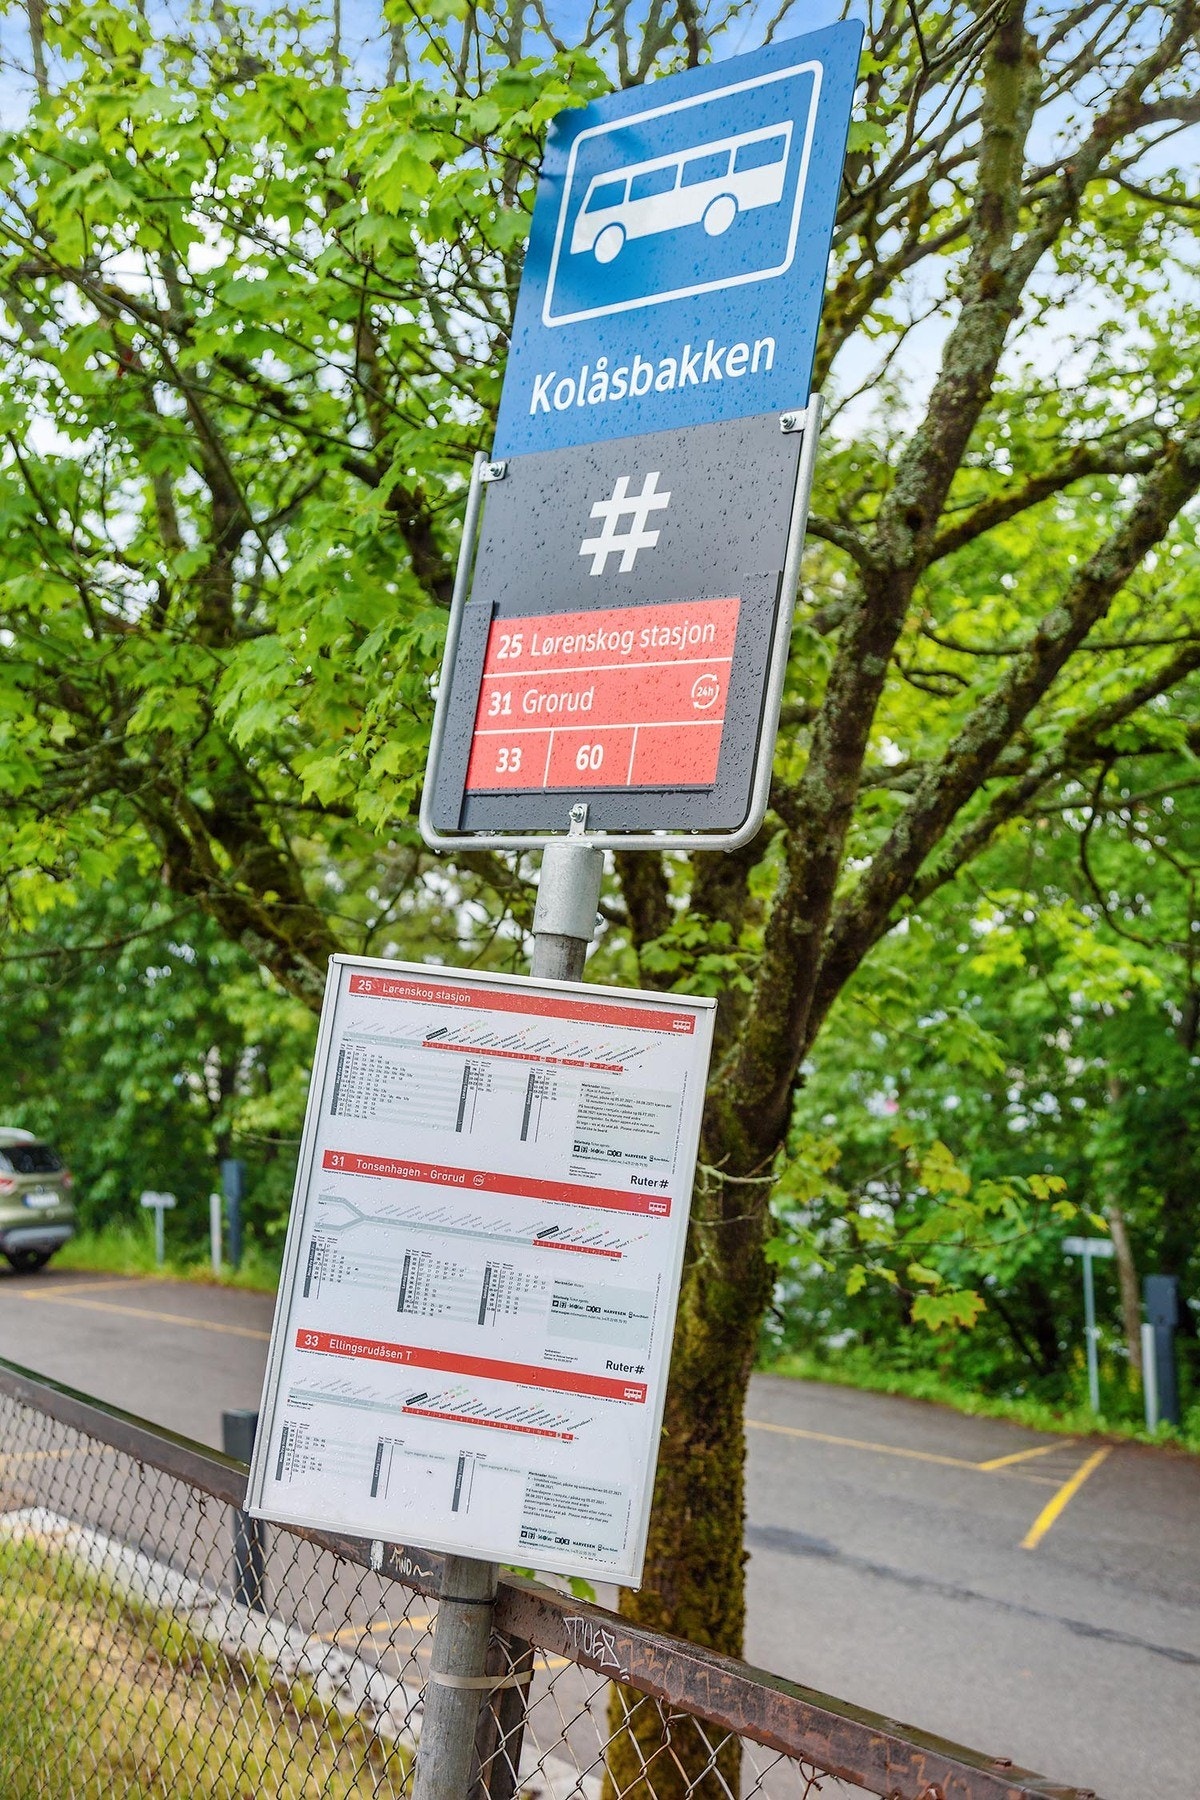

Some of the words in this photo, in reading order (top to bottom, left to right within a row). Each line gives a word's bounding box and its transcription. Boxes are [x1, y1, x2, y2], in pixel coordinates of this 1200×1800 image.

[529, 337, 776, 415] Kolåsbakken
[497, 633, 522, 659] 25
[530, 628, 634, 656] Lørenskog
[639, 620, 716, 650] stasjon
[488, 691, 512, 716] 31
[522, 686, 594, 714] Grorud
[696, 686, 714, 698] 24h
[495, 748, 522, 772] 33
[576, 744, 604, 770] 60
[358, 980, 372, 991] 25
[382, 983, 434, 1000] Lørenskog
[436, 990, 470, 1003] stasjon
[331, 1155, 344, 1167] 31
[356, 1159, 420, 1178] Tonsenhagen
[430, 1170, 465, 1183] Grorud
[304, 1334, 318, 1347] 33
[329, 1338, 403, 1360] Ellingsrudåsen
[406, 1350, 412, 1360] T
